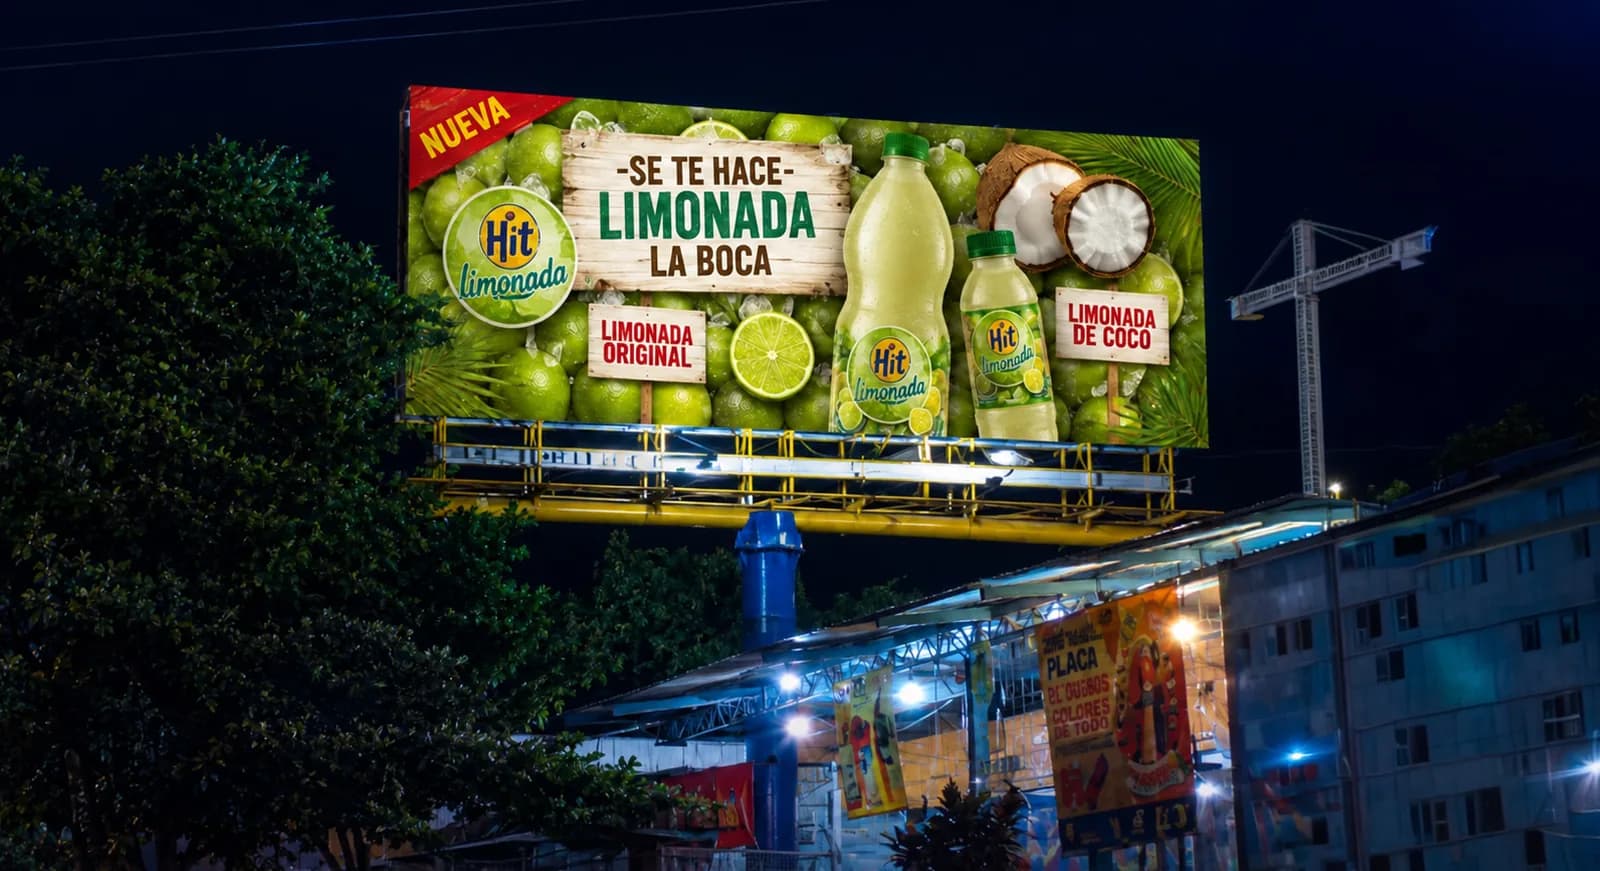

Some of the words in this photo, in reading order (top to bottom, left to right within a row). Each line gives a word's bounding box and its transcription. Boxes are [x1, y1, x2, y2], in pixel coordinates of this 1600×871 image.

[419, 96, 511, 159] NUEVA
[676, 157, 702, 185] TE
[599, 190, 816, 240] LIMONADA
[485, 212, 534, 263] Hit
[650, 245, 687, 277] LA
[695, 245, 772, 277] BOCA
[459, 262, 568, 300] limonada
[1068, 303, 1156, 329] LIMONADA
[601, 320, 694, 346] LIMONADA
[989, 322, 1016, 352] Hit
[1073, 324, 1097, 347] DE
[1102, 325, 1152, 350] COCO
[603, 341, 692, 369] ORIGINAL
[874, 343, 906, 377] Hit
[981, 344, 1034, 374] limonada
[854, 375, 925, 405] limonada
[1046, 646, 1098, 681] PLACA
[1052, 699, 1110, 725] COLORES
[1054, 723, 1071, 740] DE
[1074, 718, 1109, 735] TODO
